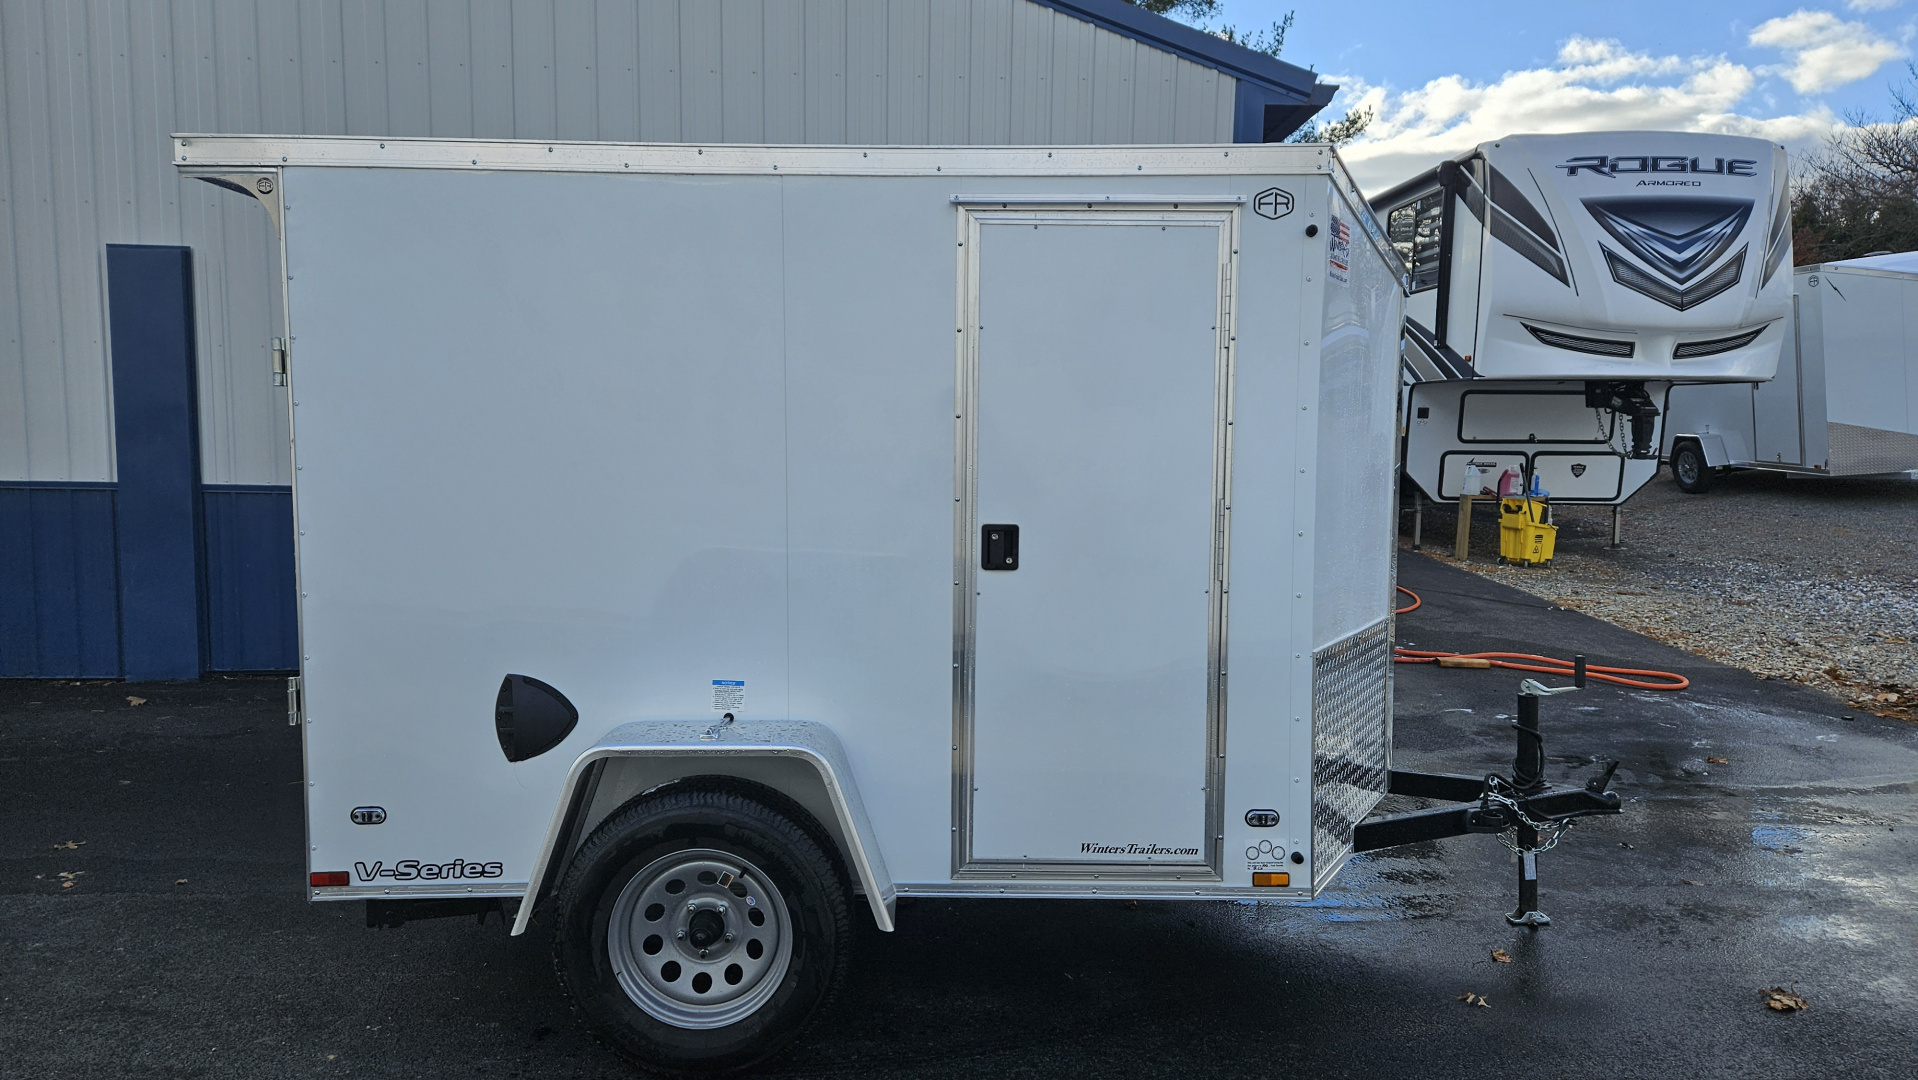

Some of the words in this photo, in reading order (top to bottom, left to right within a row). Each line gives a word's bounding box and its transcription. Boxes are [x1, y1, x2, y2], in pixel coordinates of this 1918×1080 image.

[1555, 155, 1757, 178] ROGUE
[1080, 842, 1199, 856] WintersTrailers.com
[354, 858, 503, 882] V-Series
